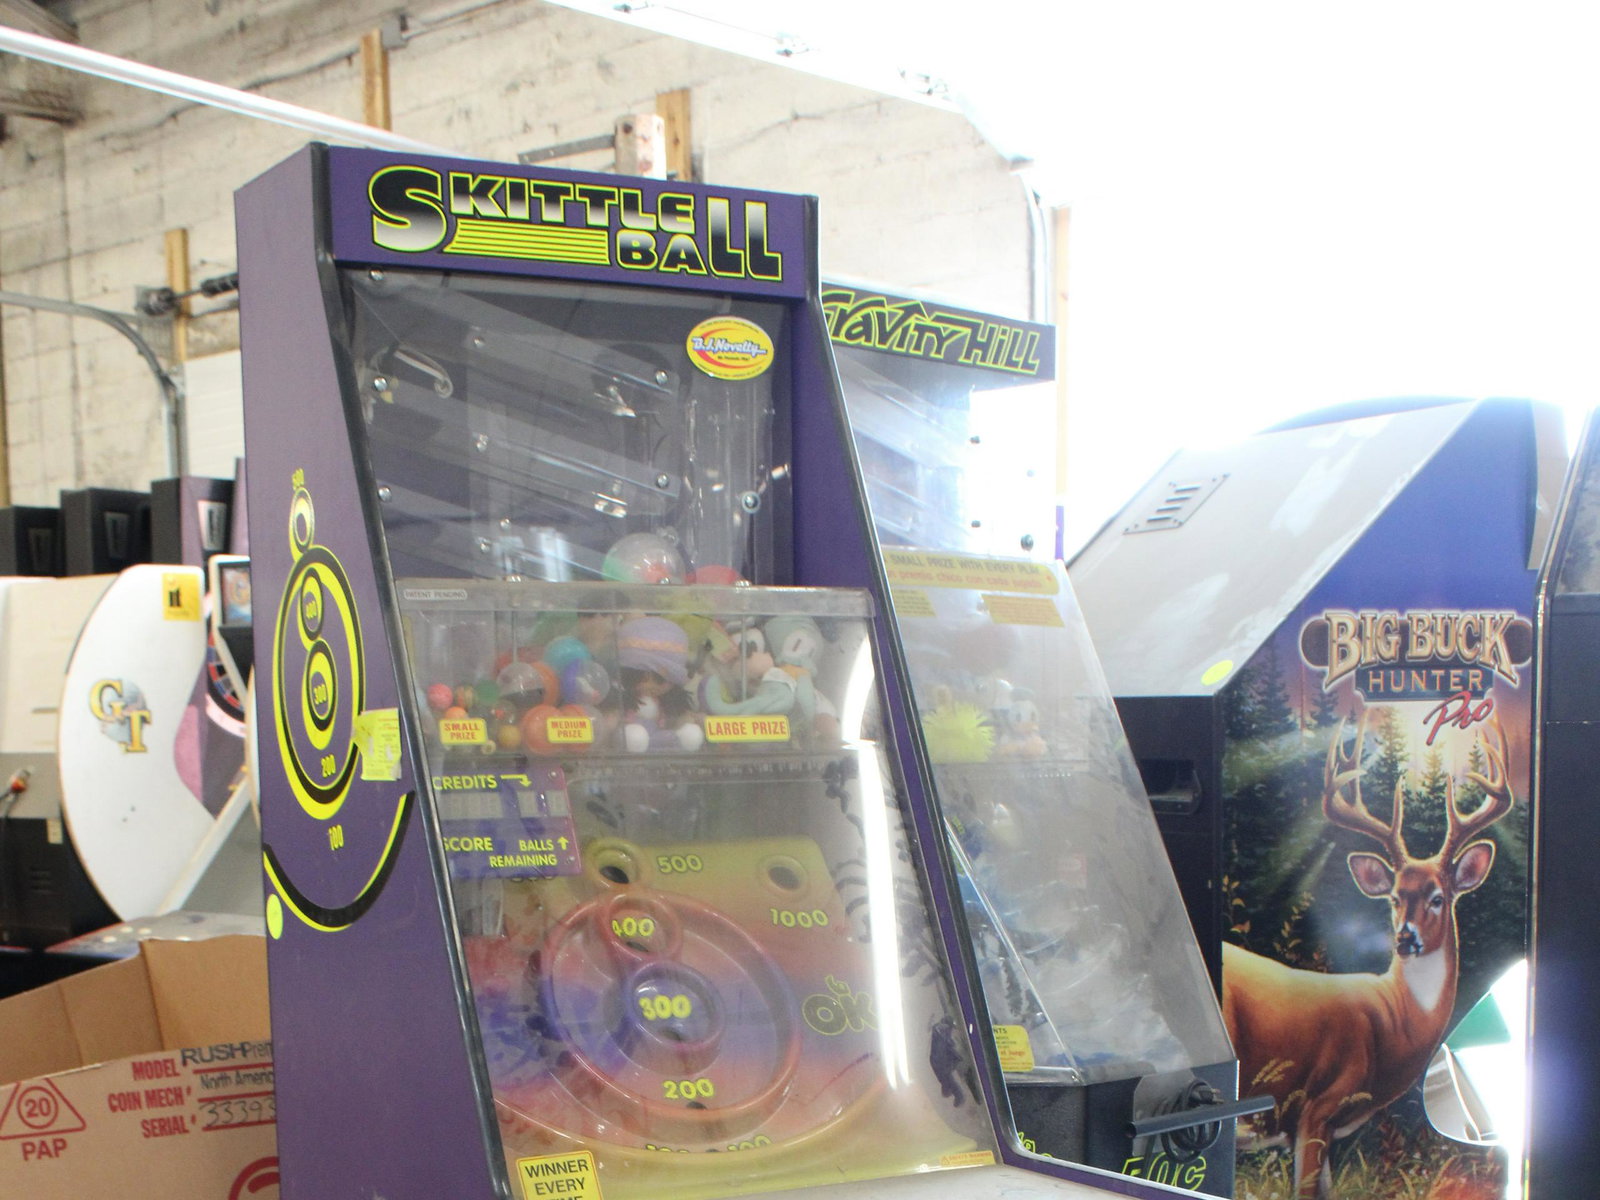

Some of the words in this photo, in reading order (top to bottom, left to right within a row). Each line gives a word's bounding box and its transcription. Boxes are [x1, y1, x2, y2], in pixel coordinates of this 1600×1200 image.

[368, 164, 695, 253] SKITTLE
[616, 196, 782, 281] BALL
[1324, 611, 1401, 690] BIG
[1406, 611, 1519, 686] BUCK
[1368, 669, 1483, 692] HUNTER
[443, 721, 481, 732] SMALL
[550, 720, 588, 731] MEDIUM
[706, 720, 748, 736] LARGE
[751, 720, 788, 736] PRIZE
[1423, 691, 1493, 746] Pro
[450, 731, 477, 741] PRIZE
[557, 728, 584, 739] PRIZE
[432, 774, 498, 791] CREDITS
[443, 836, 493, 851] SCORE
[518, 839, 555, 852] BALLS
[489, 854, 559, 869] REMAINING
[657, 854, 703, 874] 500
[769, 908, 829, 928] 1000
[638, 995, 692, 1021] 300
[131, 1059, 181, 1082] MODEL
[662, 1078, 715, 1100] 200
[25, 1098, 50, 1118] 20
[107, 1093, 142, 1113] COIN
[144, 1086, 184, 1109] MECH
[140, 1115, 190, 1139] SERIAL
[21, 1137, 68, 1162] PAP
[525, 1158, 589, 1178] WINNER
[534, 1177, 586, 1196] EVERY
